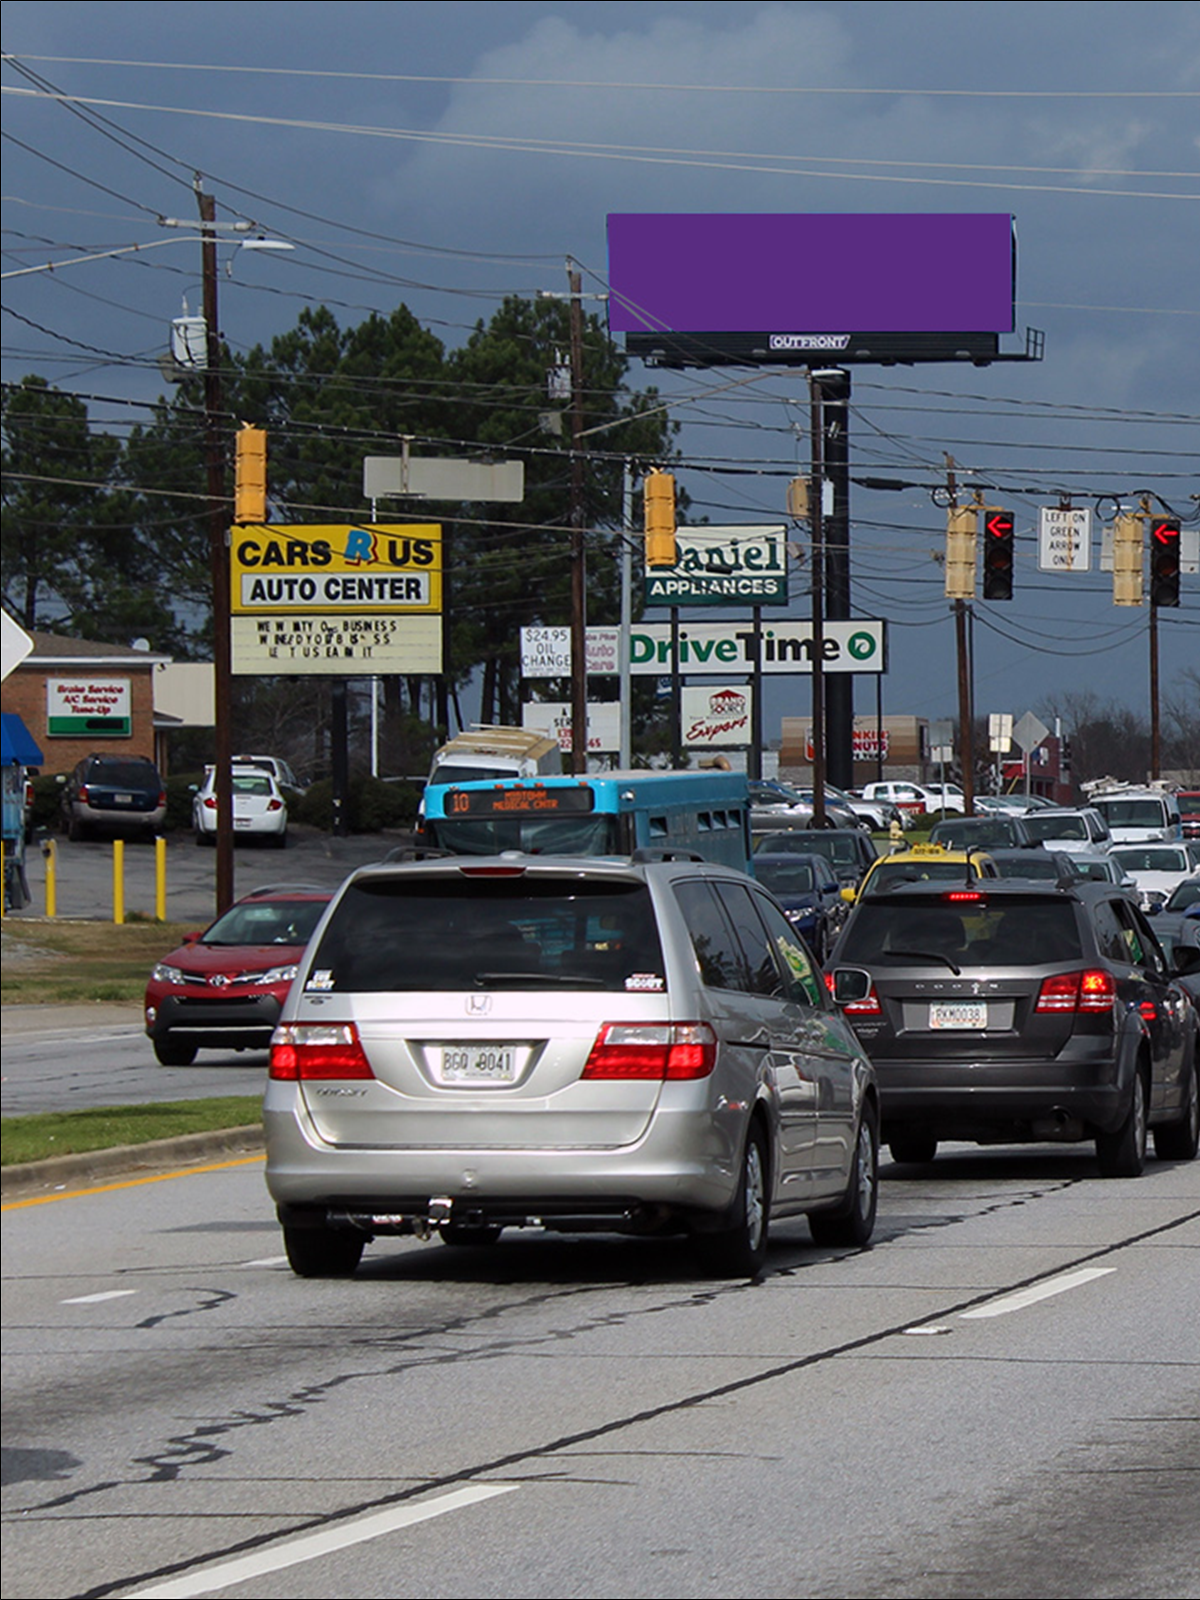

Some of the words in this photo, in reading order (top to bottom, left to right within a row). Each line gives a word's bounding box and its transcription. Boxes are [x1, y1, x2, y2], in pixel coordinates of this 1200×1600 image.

[773, 336, 846, 347] OUTFRONT
[1045, 513, 1067, 522] LEFT
[1072, 513, 1085, 522] ON
[1050, 526, 1080, 537] GREEN
[237, 540, 332, 566] CARS
[343, 529, 379, 566] R
[388, 540, 434, 565] US
[1049, 541, 1081, 551] ARROW
[1052, 555, 1076, 566] ONLY
[250, 578, 316, 601] AUTO
[324, 578, 421, 601] CENTER
[650, 579, 778, 596] APPLIANCES
[526, 629, 568, 642] $24.95
[536, 643, 556, 654] OIL
[630, 631, 840, 663] DriveTime
[522, 654, 572, 667] CHANGE
[88, 684, 124, 694] Service
[83, 695, 118, 704] Service
[686, 715, 748, 741] Expert
[852, 730, 890, 740] NKIN'
[852, 741, 888, 752] NUTS
[452, 792, 470, 812] 10
